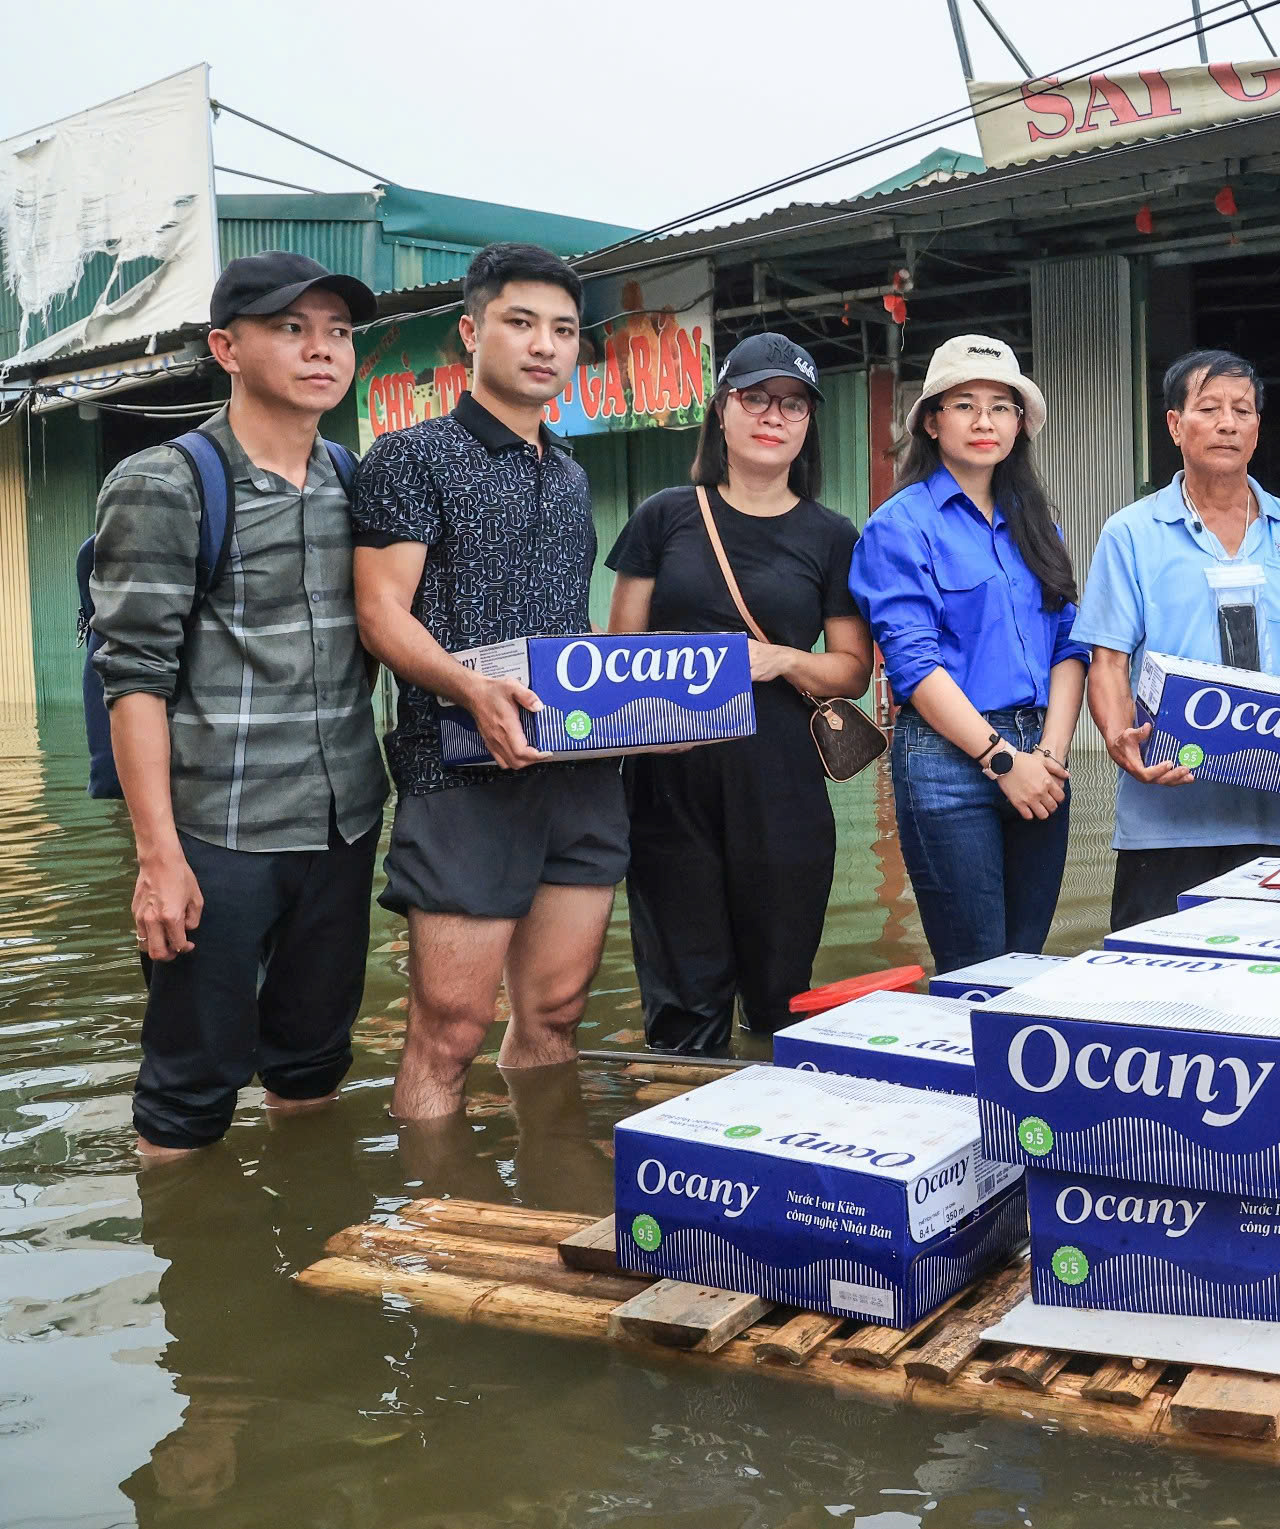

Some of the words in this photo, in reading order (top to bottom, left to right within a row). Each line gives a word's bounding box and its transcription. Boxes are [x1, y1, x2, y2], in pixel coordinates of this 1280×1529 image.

[630, 306, 704, 413] RÁN
[967, 346, 1001, 358] Thinking
[556, 640, 729, 695] Ocany
[1086, 954, 1239, 973] Ocany
[905, 1039, 974, 1056] any
[1007, 1024, 1276, 1128] Ocany
[765, 1132, 916, 1168] Ocany
[636, 1159, 761, 1218] Ocany
[914, 1155, 970, 1205] Ocany
[786, 1189, 813, 1207] Nước
[815, 1195, 836, 1210] I-on
[836, 1198, 866, 1217] Kiềm
[945, 1209, 958, 1223] 350
[958, 1204, 966, 1216] ml
[1055, 1186, 1208, 1238] Ocany
[1239, 1200, 1271, 1217] Nước
[786, 1210, 811, 1226] công
[813, 1215, 838, 1232] nghệ
[840, 1218, 868, 1236] Nhật
[870, 1224, 892, 1240] Bản
[919, 1225, 930, 1239] 8,4
[930, 1223, 936, 1233] L
[1239, 1220, 1270, 1236] công
